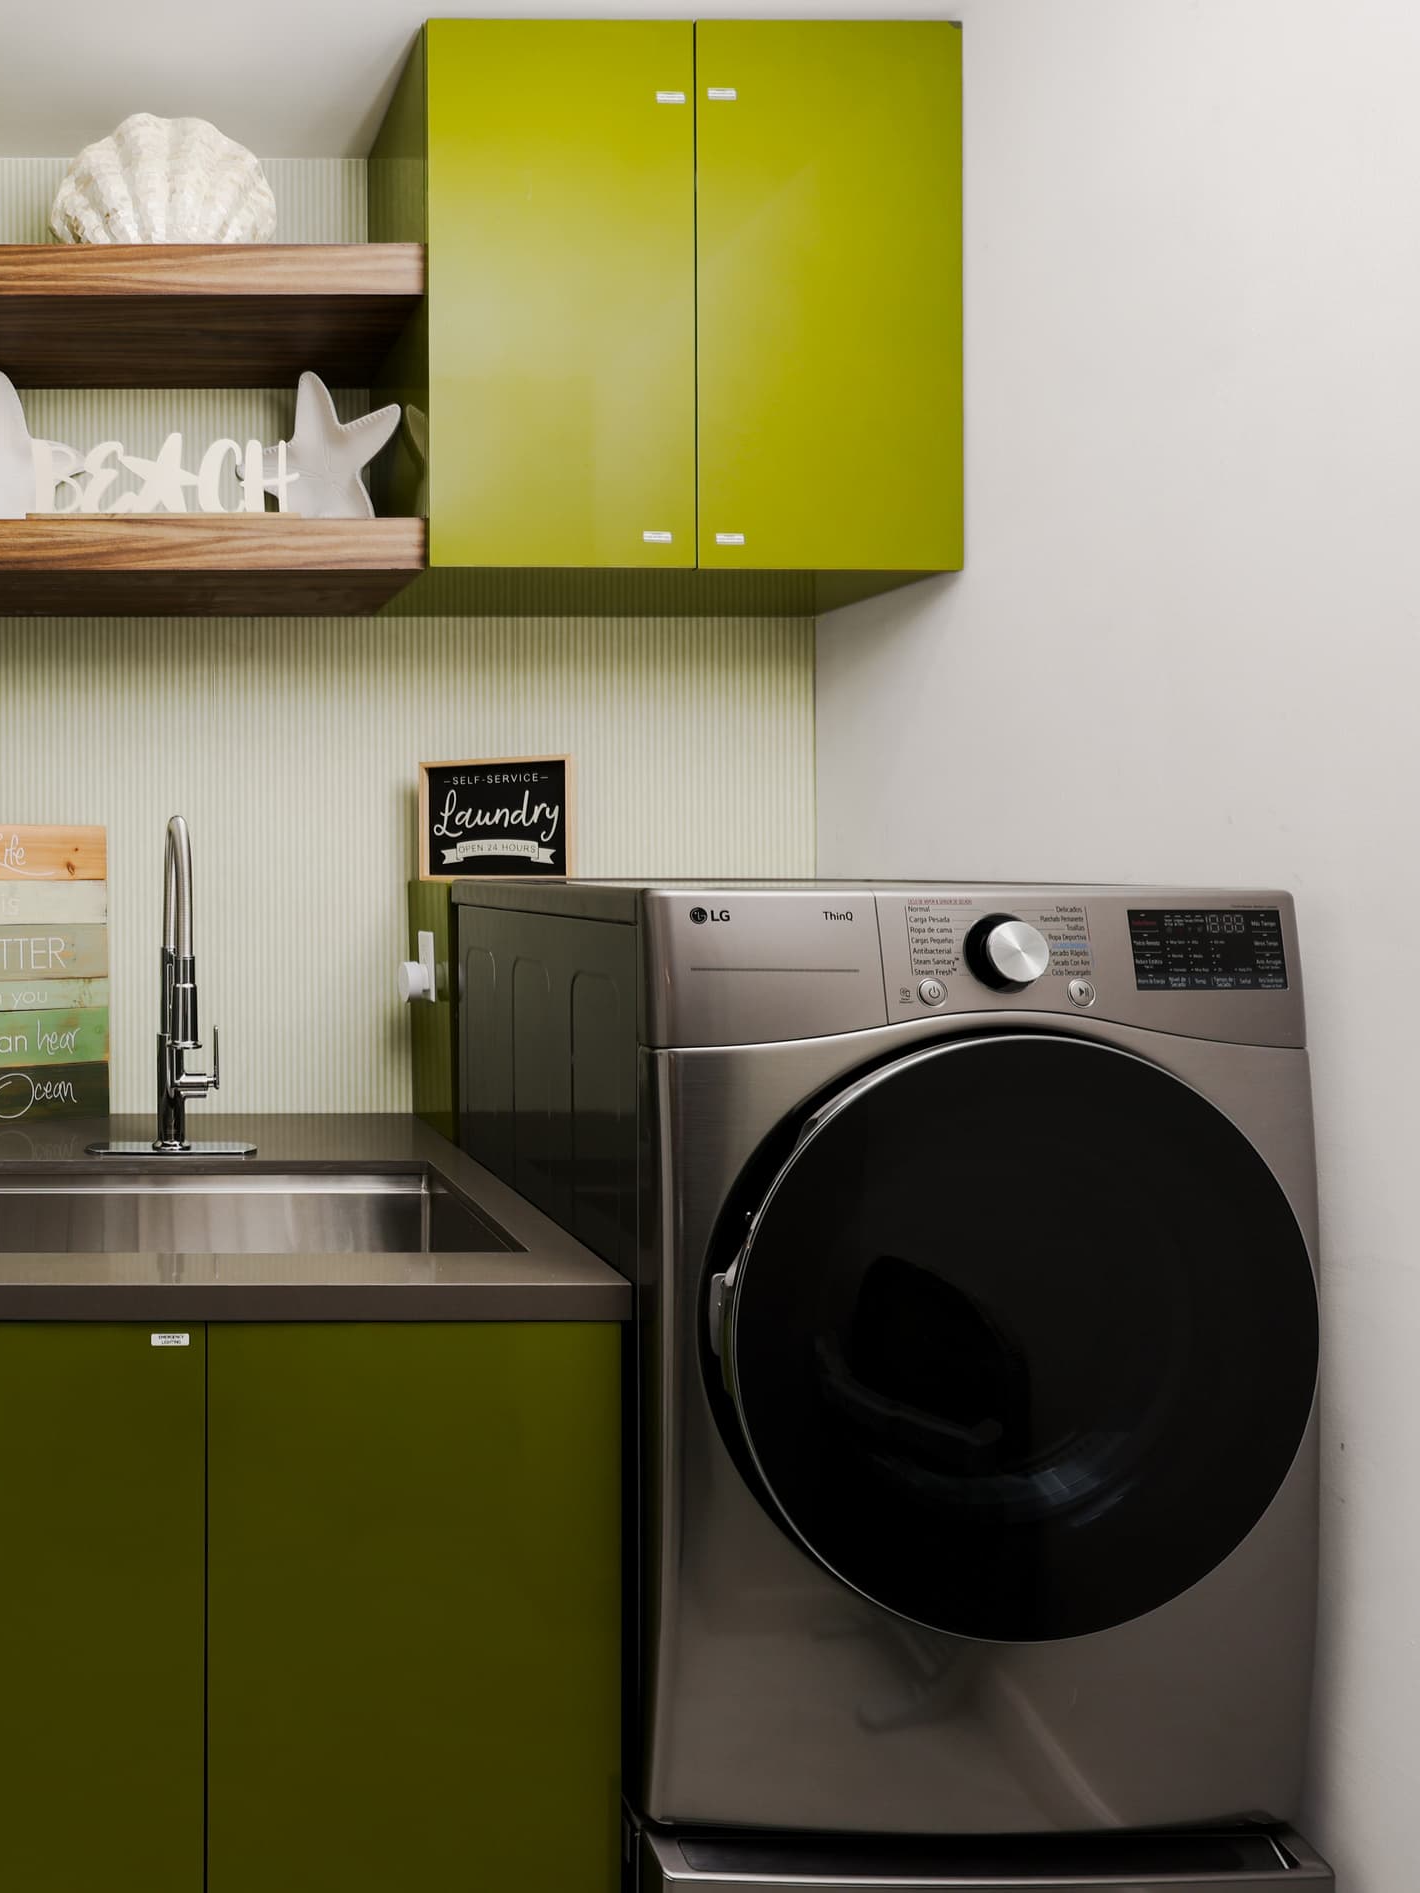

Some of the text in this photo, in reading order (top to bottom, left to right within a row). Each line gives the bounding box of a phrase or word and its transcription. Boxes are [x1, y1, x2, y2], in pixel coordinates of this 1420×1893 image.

[433, 789, 560, 842] Laundry
[458, 845, 484, 854] OPEN
[502, 844, 536, 854] HOURS
[711, 911, 730, 922] LG
[823, 911, 853, 922] ThinQ
[909, 916, 927, 924] Carga
[910, 927, 926, 935] Ropa
[911, 937, 954, 945] Cargas Pequeñas
[12, 989, 49, 1010] you
[36, 1019, 80, 1056] hear
